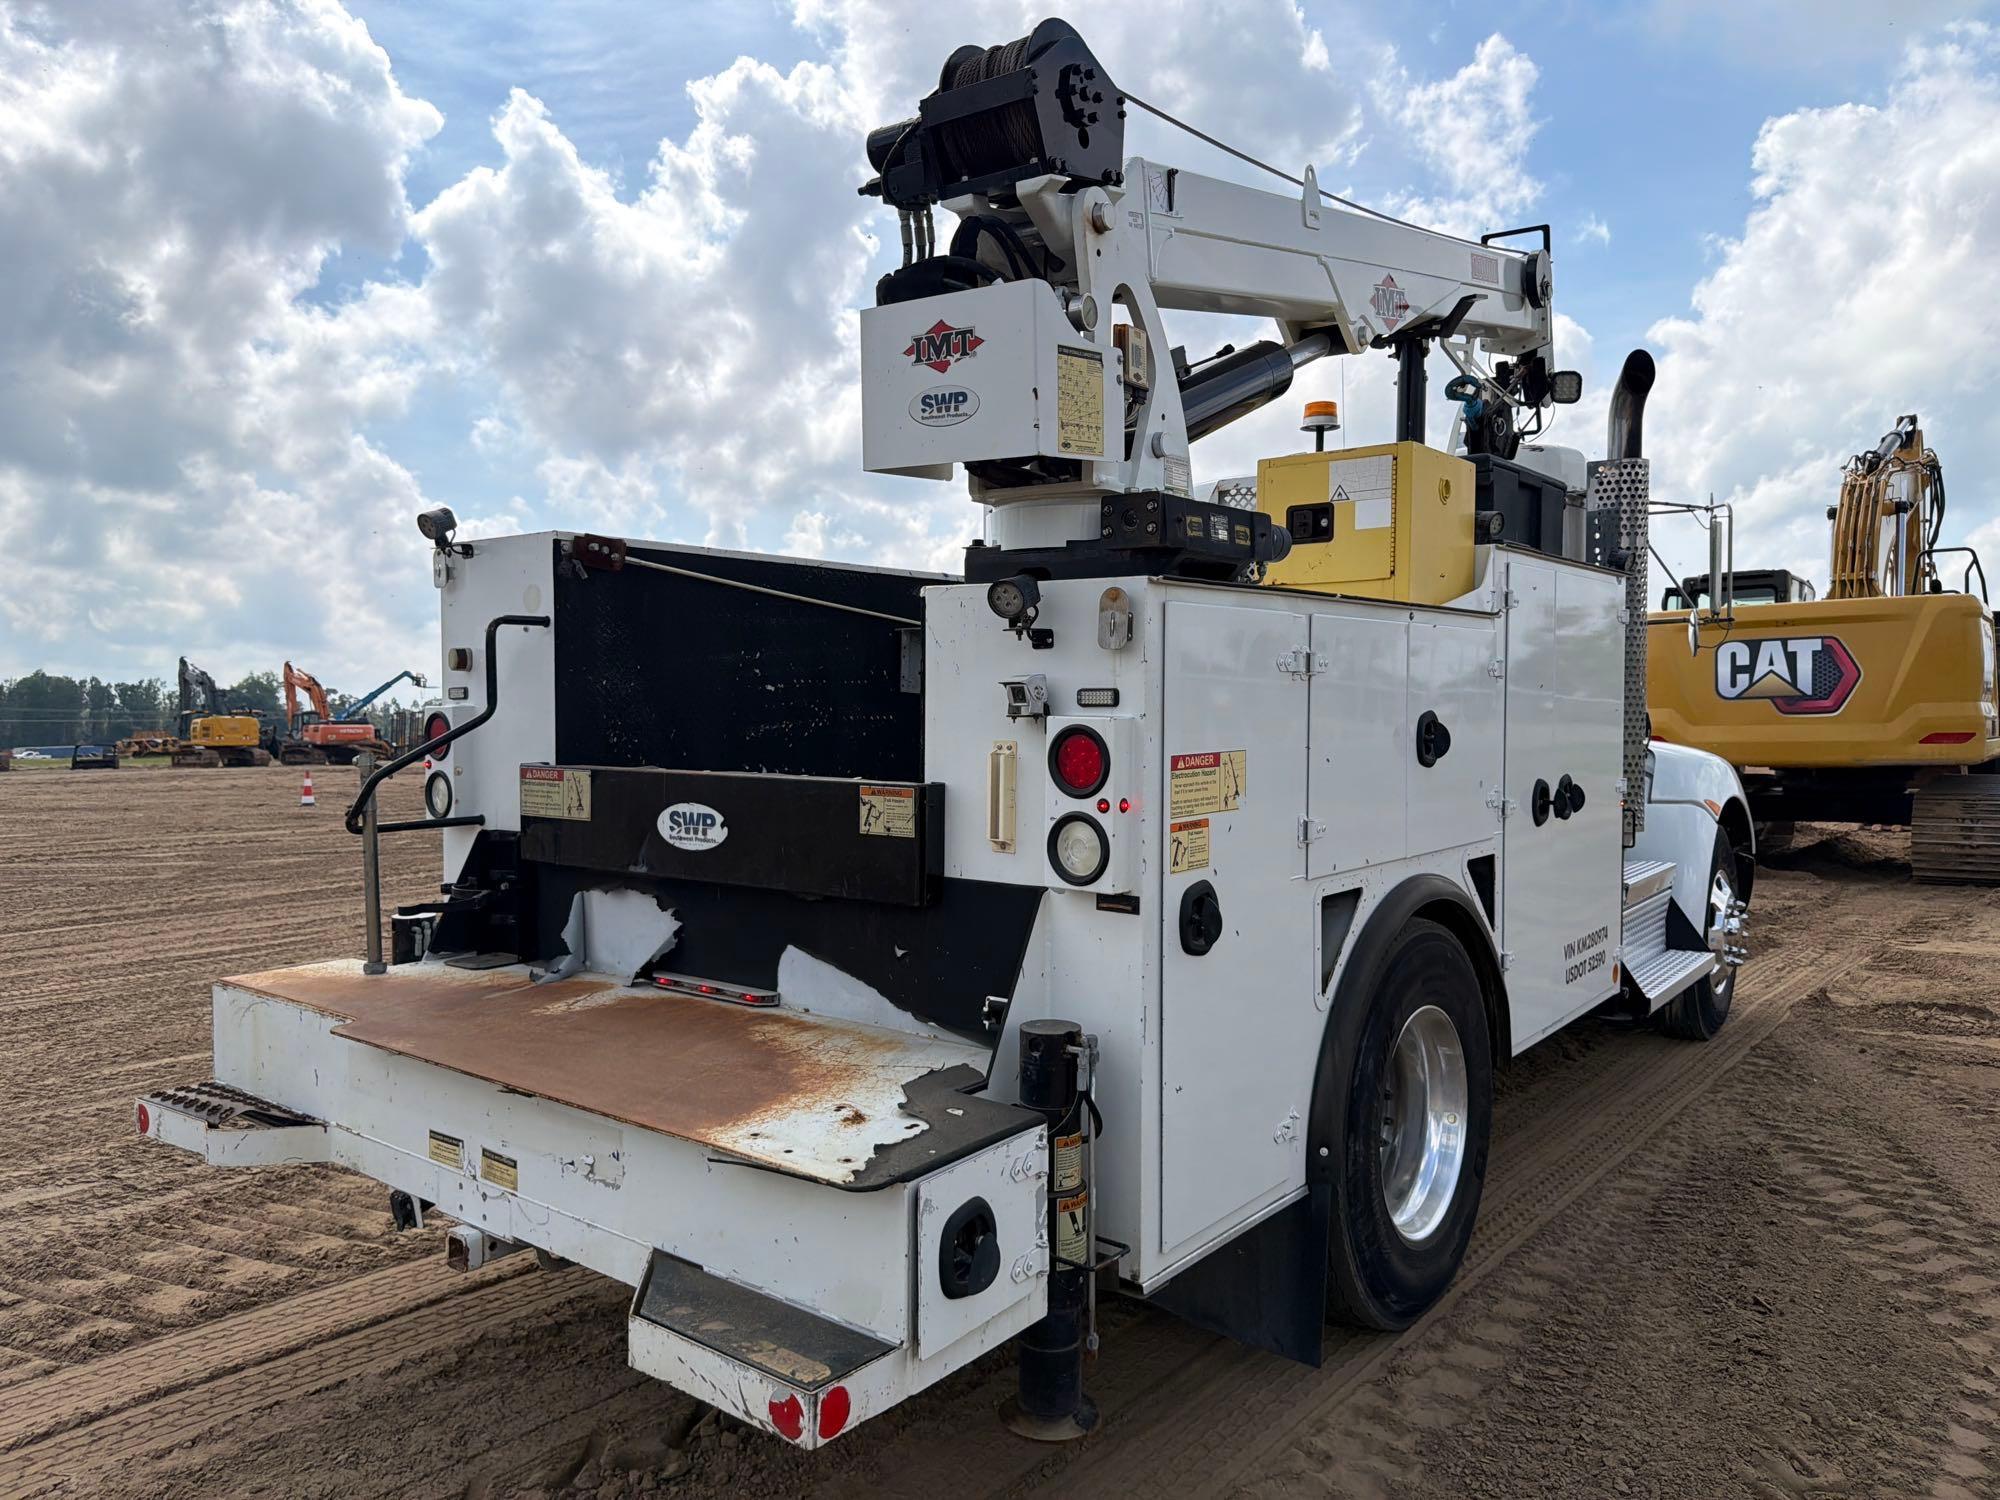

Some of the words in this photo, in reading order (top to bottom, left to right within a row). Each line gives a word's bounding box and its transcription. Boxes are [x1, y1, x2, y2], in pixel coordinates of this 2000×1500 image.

[1374, 286, 1405, 319] IMT
[912, 327, 975, 366] IMT
[920, 391, 968, 415] SWP
[1716, 638, 1822, 698] CAT
[1185, 754, 1215, 767] DANGER
[532, 770, 559, 779] DANGER
[1171, 770, 1200, 780] Electrocution
[1201, 769, 1217, 777] Hazard
[669, 810, 717, 837] SWP
[1563, 941, 1576, 961] VIN
[1565, 959, 1587, 985] USDOT
